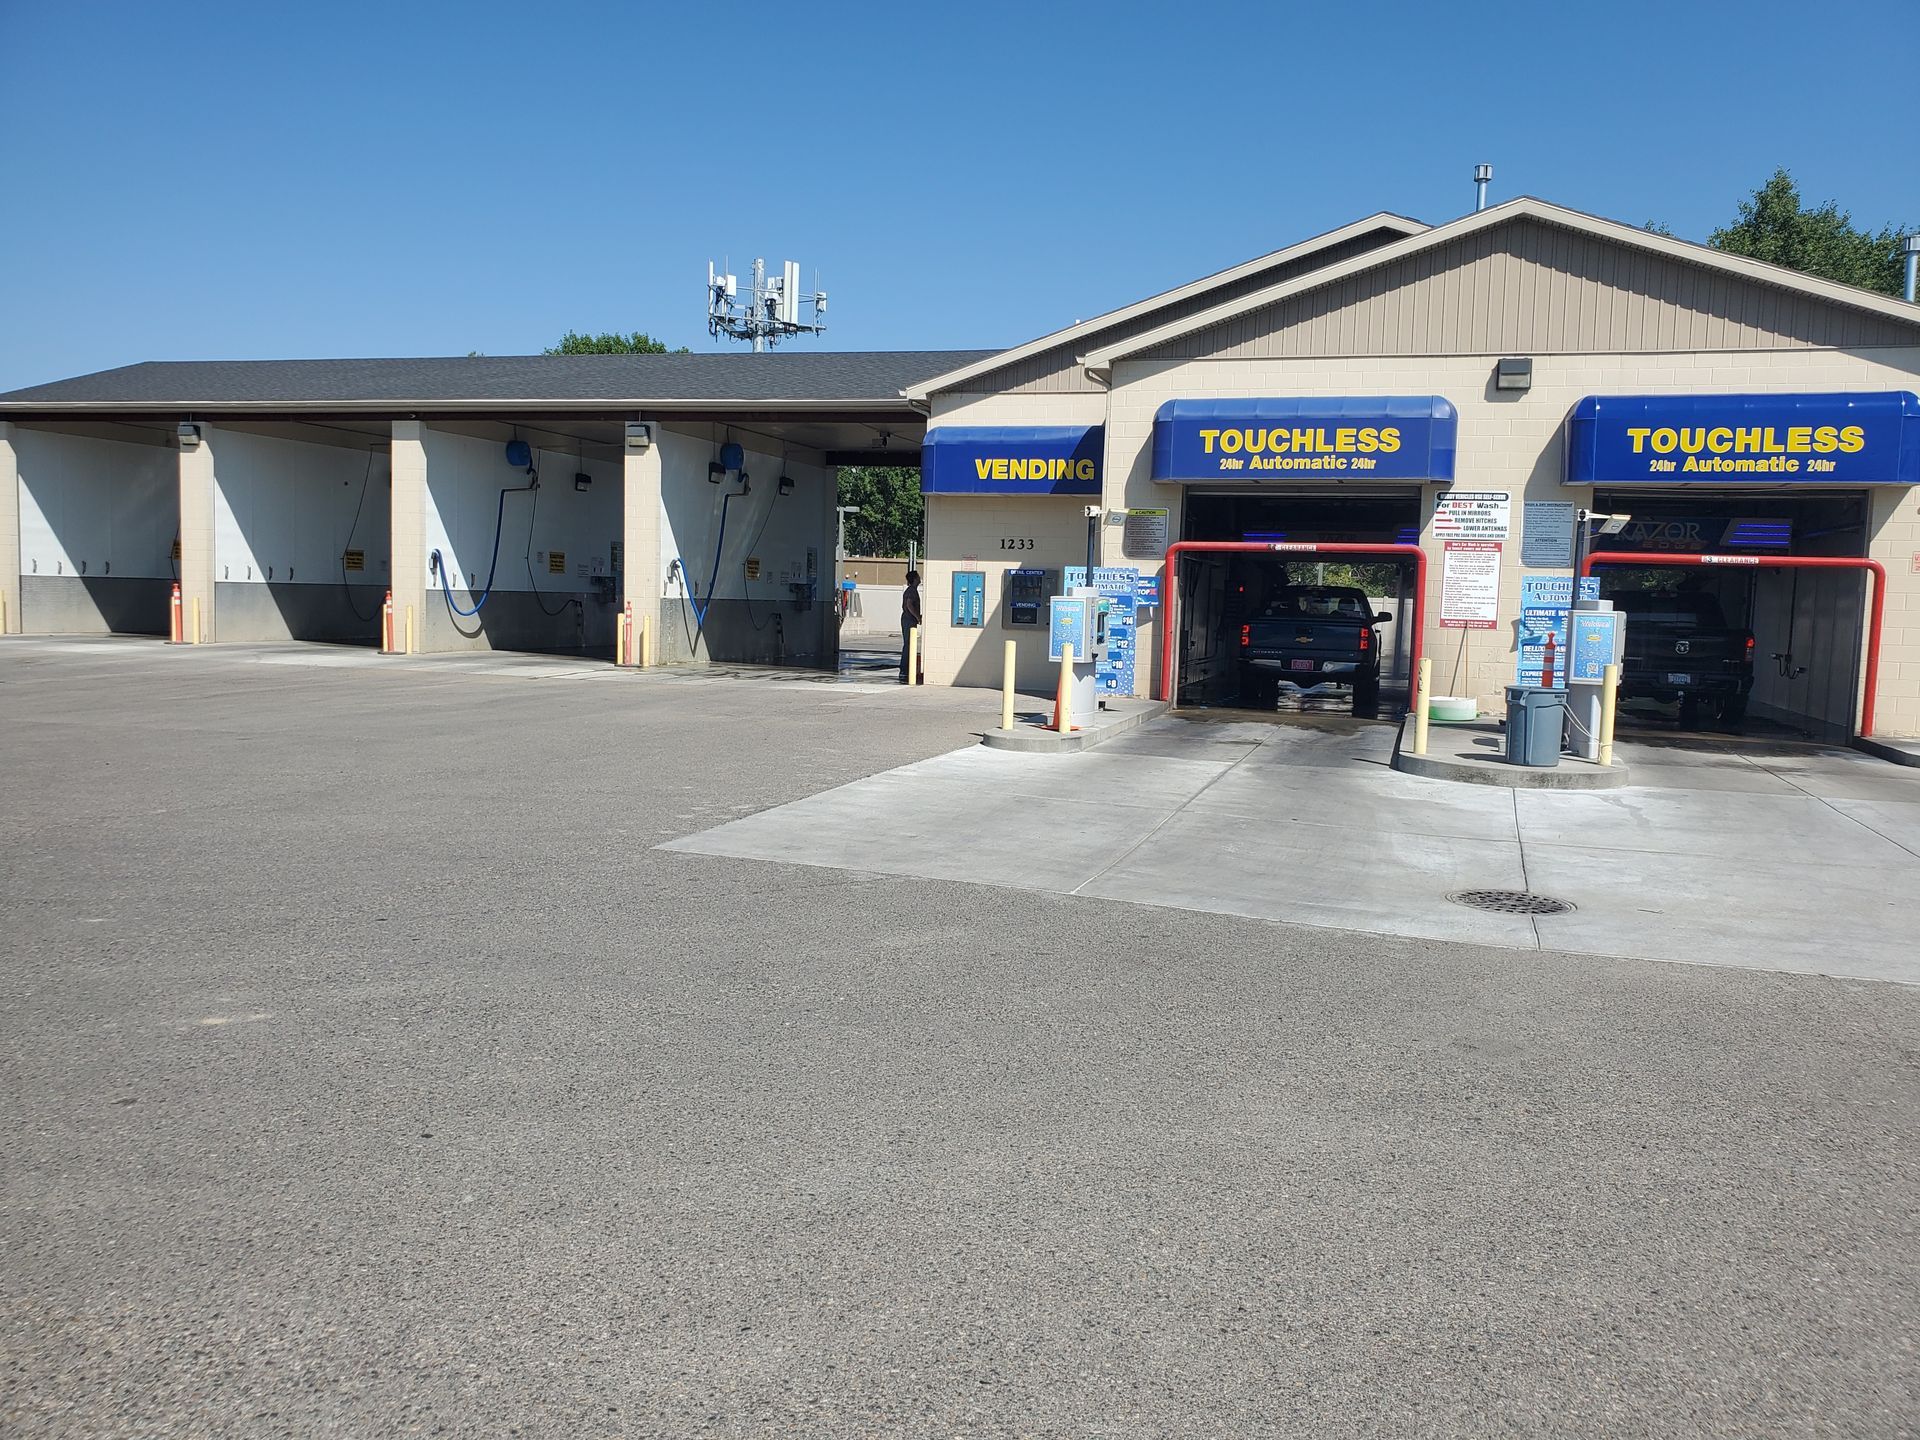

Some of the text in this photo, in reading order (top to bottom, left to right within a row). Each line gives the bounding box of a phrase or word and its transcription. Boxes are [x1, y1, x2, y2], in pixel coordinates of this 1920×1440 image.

[1200, 427, 1401, 454] TOUCHLESS
[1627, 425, 1865, 454] TOUCHLESS
[1219, 454, 1376, 470] 24hr Automatic 24hr
[1650, 455, 1836, 472] 24hr Automatic 24hr
[974, 458, 1096, 480] VENDING
[1436, 501, 1450, 509] For
[1000, 538, 1035, 550] 1233
[1068, 572, 1135, 583] TOCHLESS
[1076, 582, 1126, 591] AOMATIC
[1525, 582, 1596, 594] TOUCHLSS
[1117, 639, 1129, 648] $12
[1112, 660, 1123, 669] $10
[1107, 679, 1117, 688] $8
